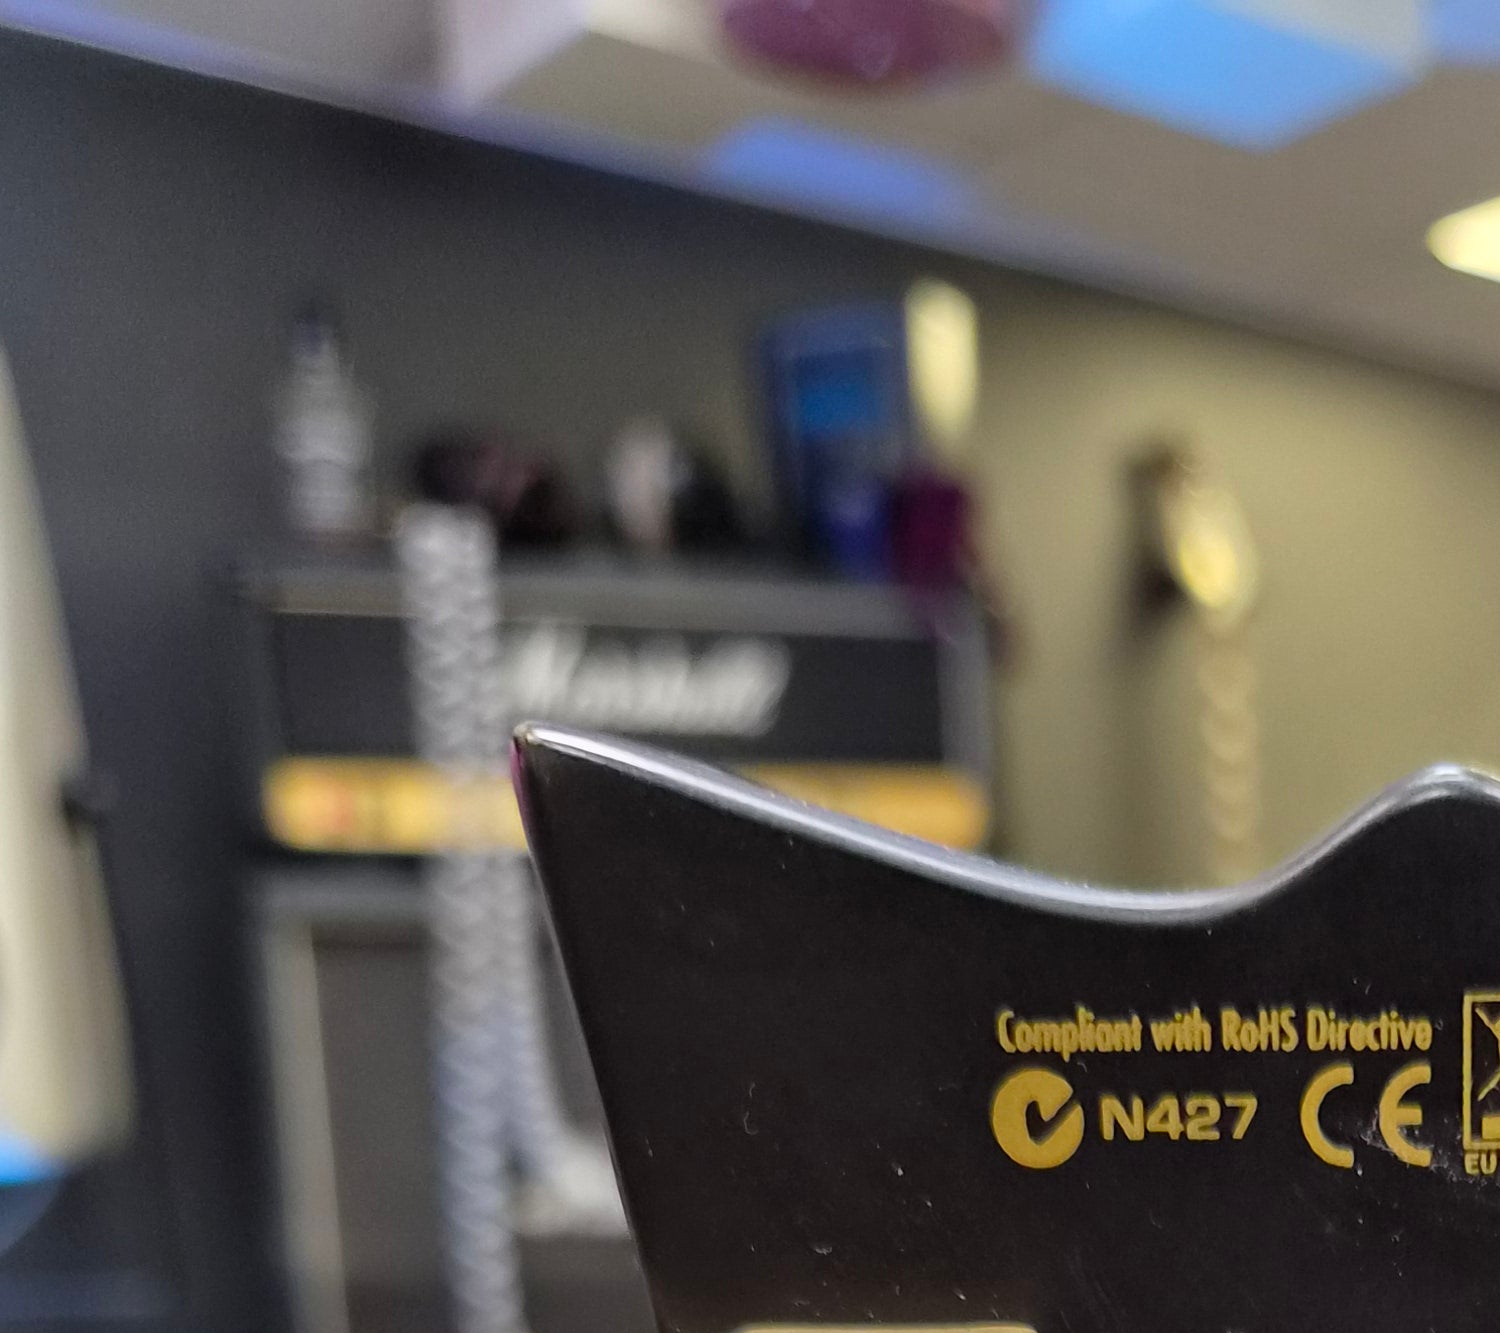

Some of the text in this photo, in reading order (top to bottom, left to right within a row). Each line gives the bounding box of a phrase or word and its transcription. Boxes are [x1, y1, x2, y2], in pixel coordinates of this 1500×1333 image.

[999, 1007, 1432, 1061] Compliant with RoHS Directive
[1100, 1097, 1258, 1141] N427
[1465, 1152, 1497, 1174] EU
